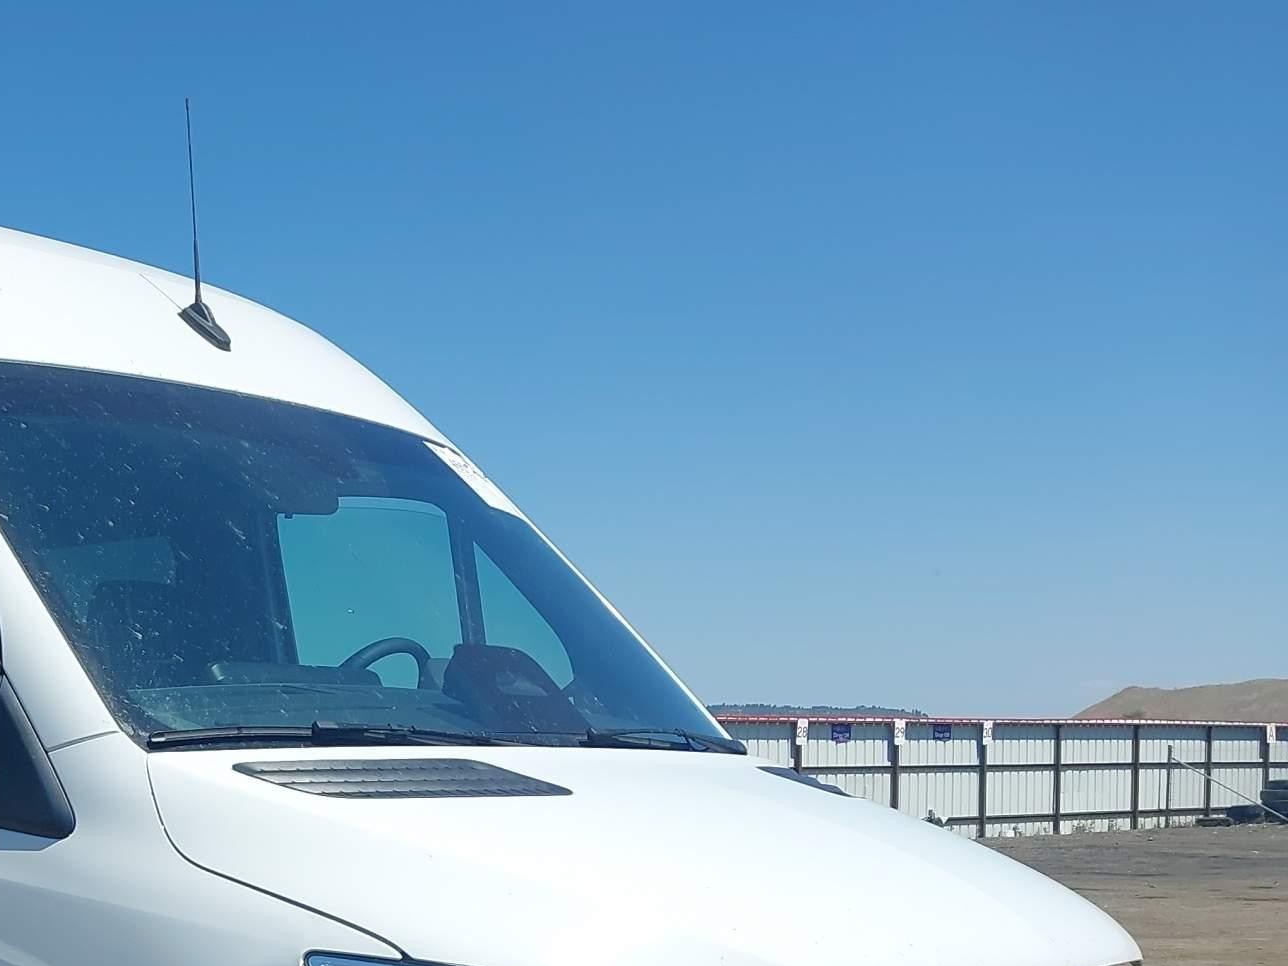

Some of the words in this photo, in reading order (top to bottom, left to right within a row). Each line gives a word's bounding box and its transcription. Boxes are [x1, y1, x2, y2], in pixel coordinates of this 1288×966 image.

[797, 726, 808, 738] 28
[895, 727, 905, 738] 29
[983, 727, 992, 738] 30
[1268, 726, 1275, 741] A
